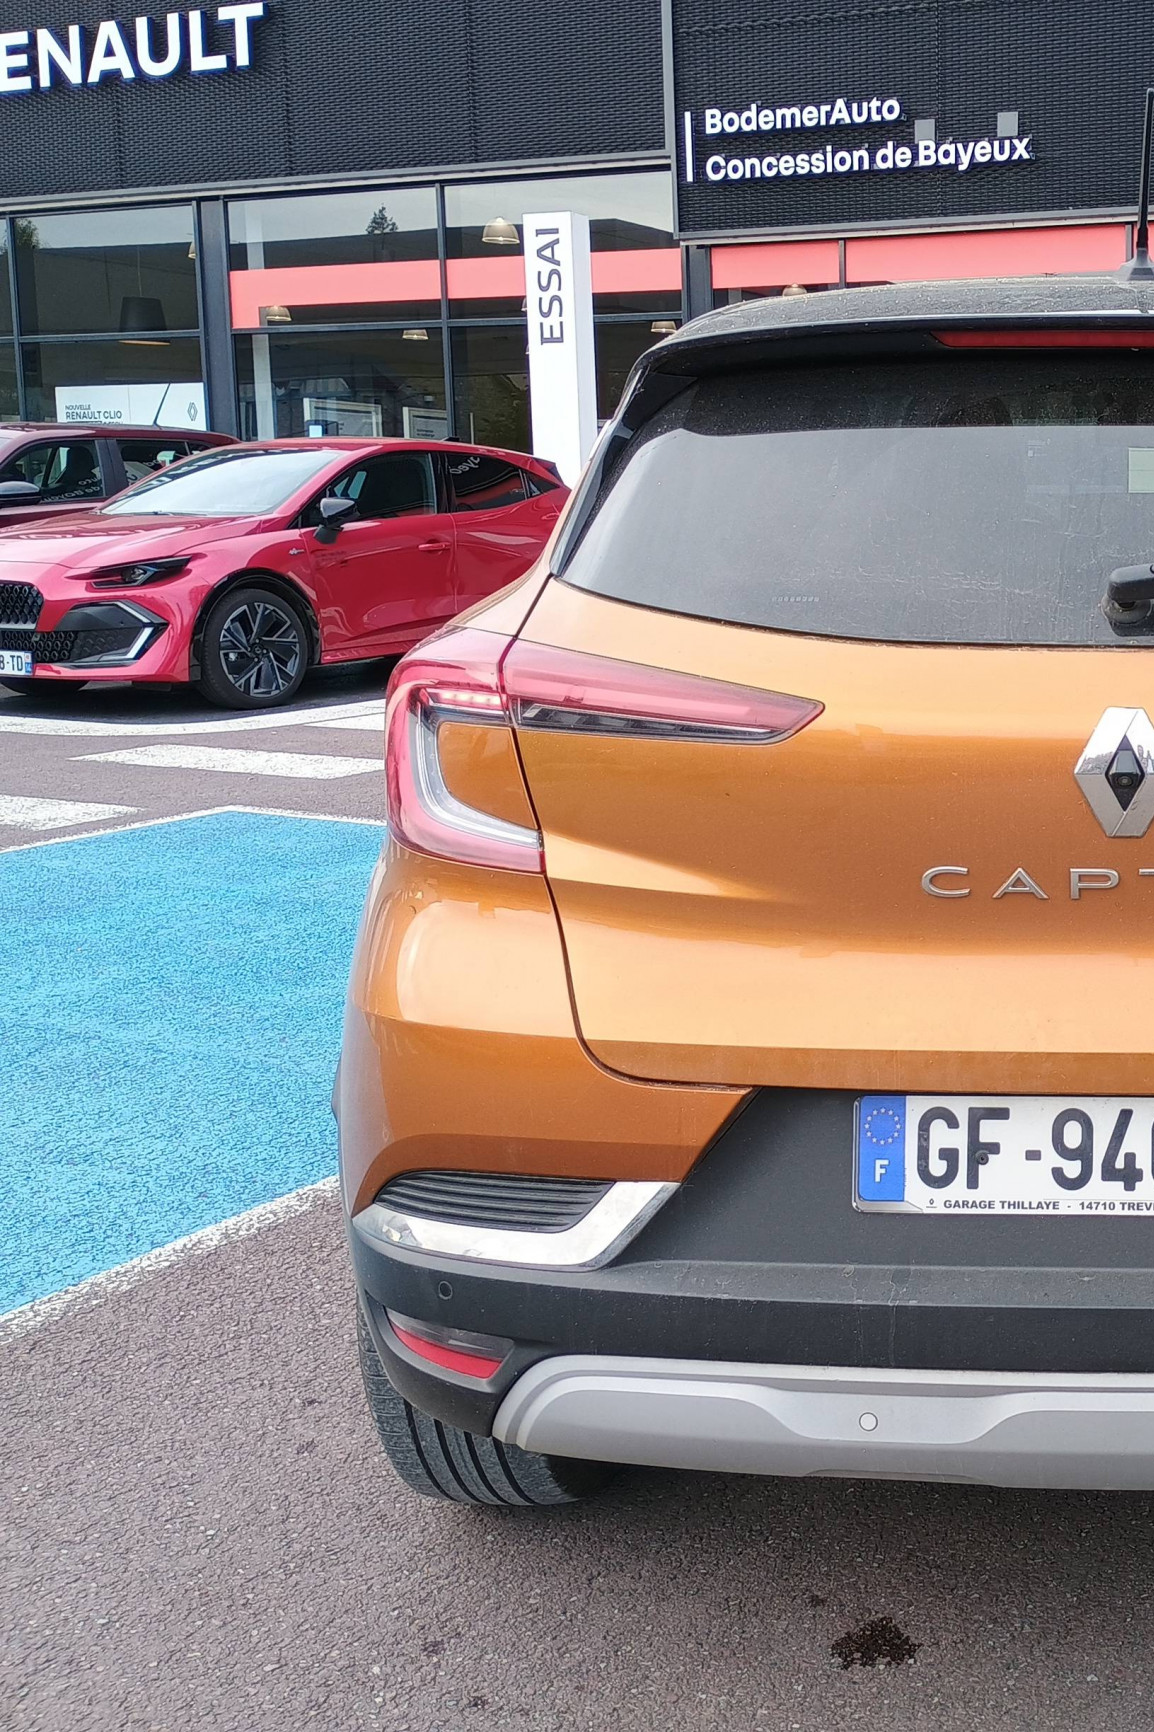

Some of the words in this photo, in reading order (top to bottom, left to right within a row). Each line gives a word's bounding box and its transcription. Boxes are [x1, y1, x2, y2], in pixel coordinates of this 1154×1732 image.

[704, 97, 902, 136] BodemerAuto
[705, 144, 869, 182] Concession
[875, 141, 913, 170] de
[917, 137, 1032, 171] Bayeux
[535, 227, 564, 346] ESSAI
[65, 411, 101, 420] RENAULT
[103, 411, 122, 419] CLIO
[874, 1159, 890, 1183] F
[943, 1199, 996, 1210] GARAGE
[999, 1200, 1060, 1210] THILLAYE
[1079, 1201, 1116, 1211] 14710
